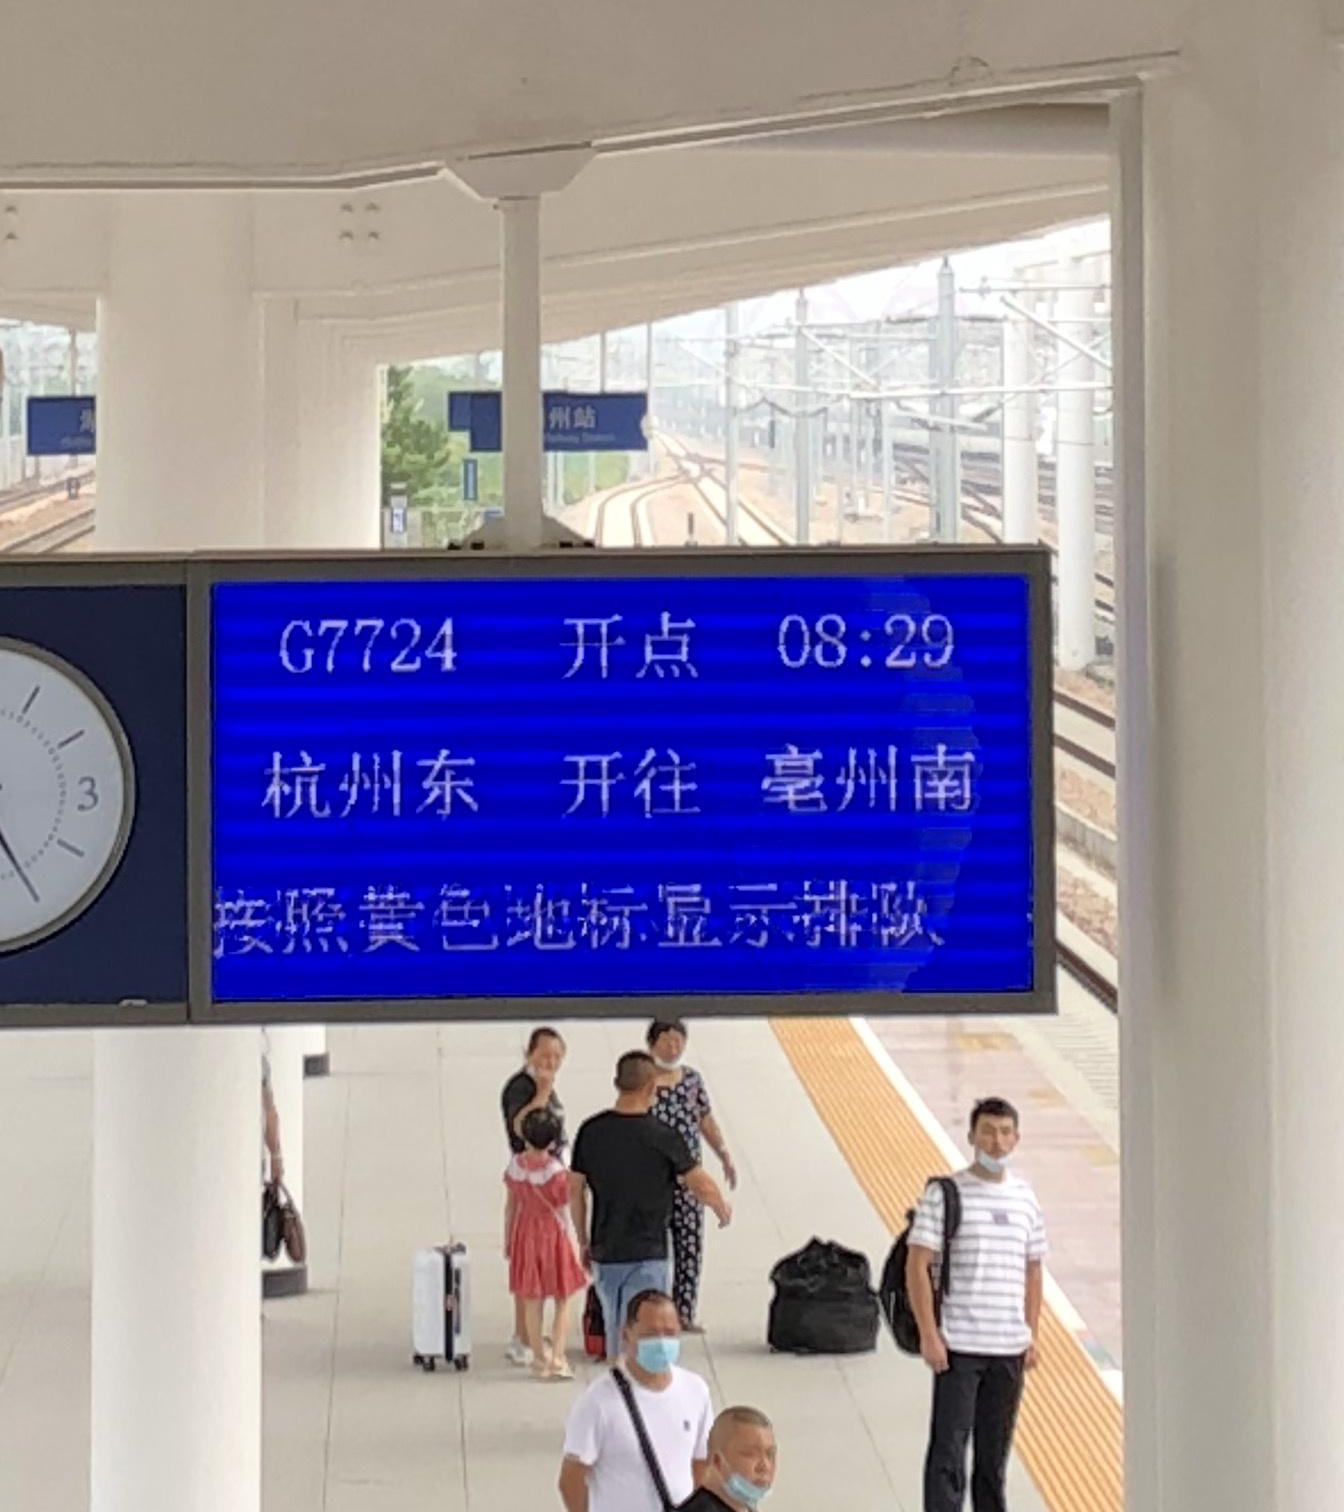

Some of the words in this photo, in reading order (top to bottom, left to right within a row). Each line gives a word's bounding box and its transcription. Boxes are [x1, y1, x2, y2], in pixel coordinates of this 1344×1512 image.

[279, 617, 458, 673] G7724
[560, 611, 699, 678] 开点
[777, 614, 955, 668] 08:29
[77, 776, 99, 811] 3
[261, 748, 479, 818] 杭州东
[560, 748, 700, 818] 开往
